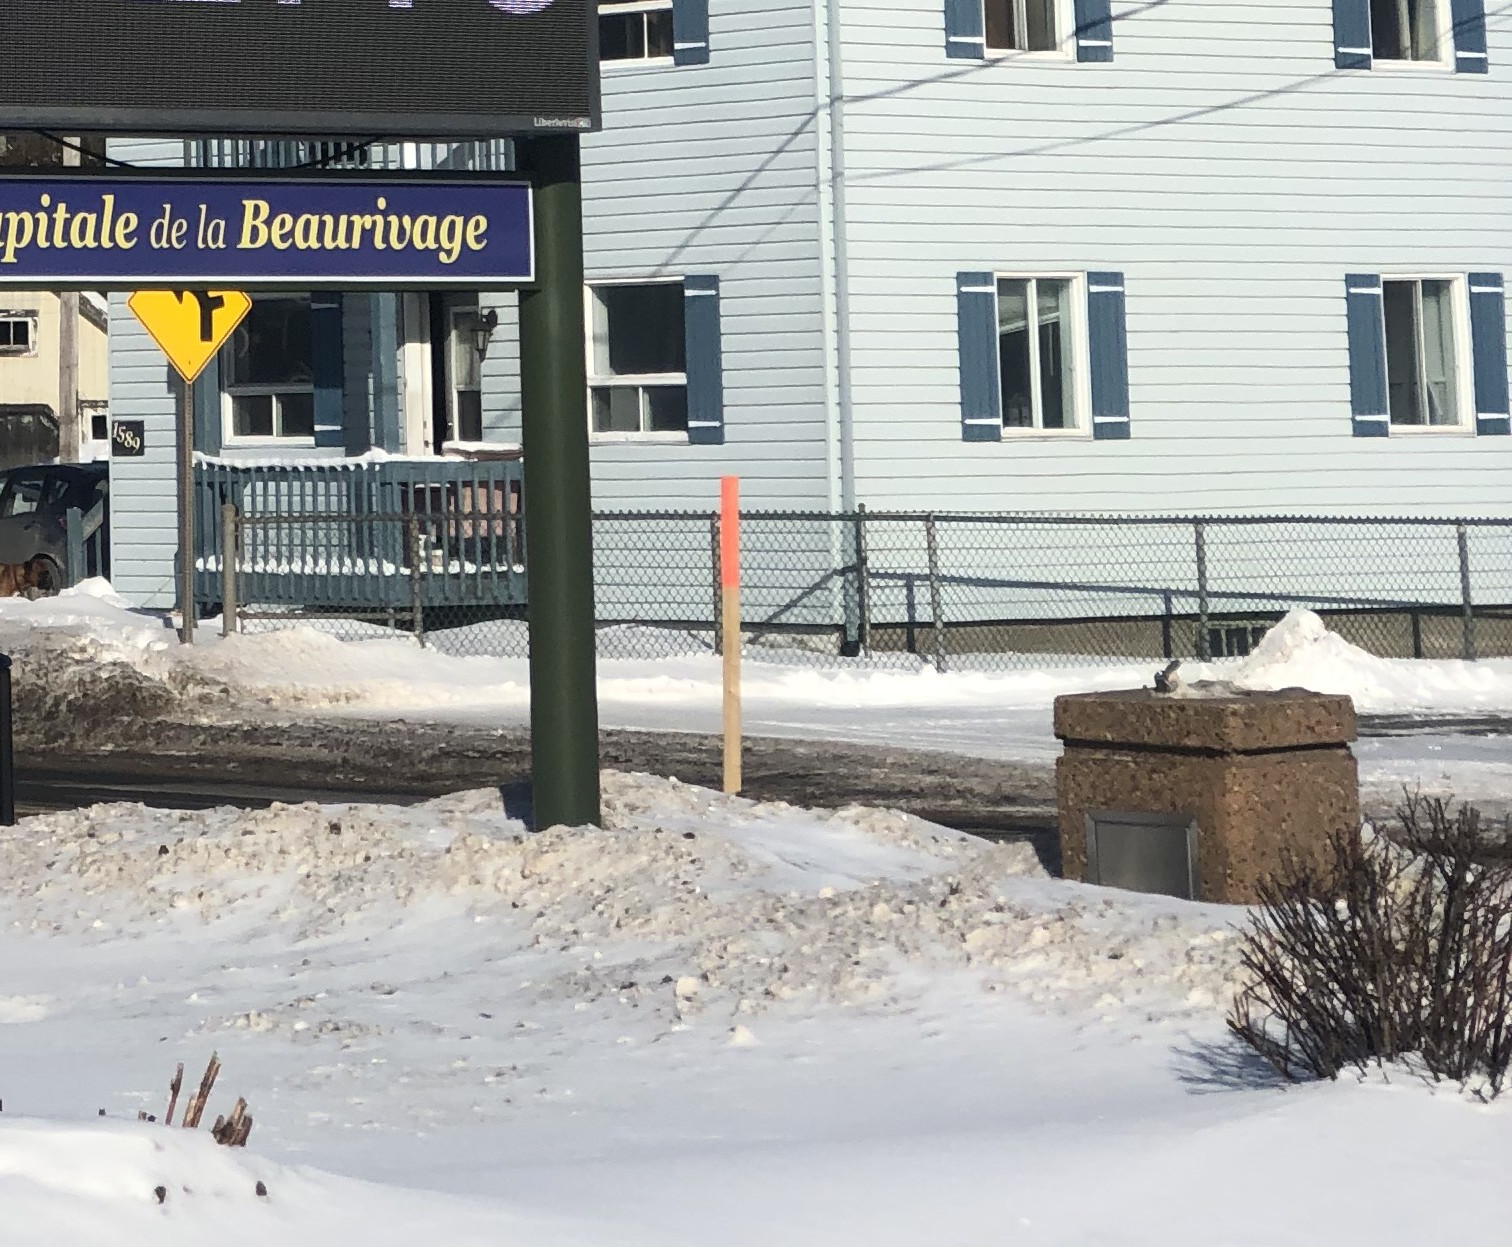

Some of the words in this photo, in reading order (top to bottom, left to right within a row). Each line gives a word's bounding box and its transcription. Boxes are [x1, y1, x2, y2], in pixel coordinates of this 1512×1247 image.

[149, 203, 189, 250] de
[196, 204, 227, 250] la
[236, 197, 489, 265] Beaurivage
[112, 421, 141, 454] 1589
